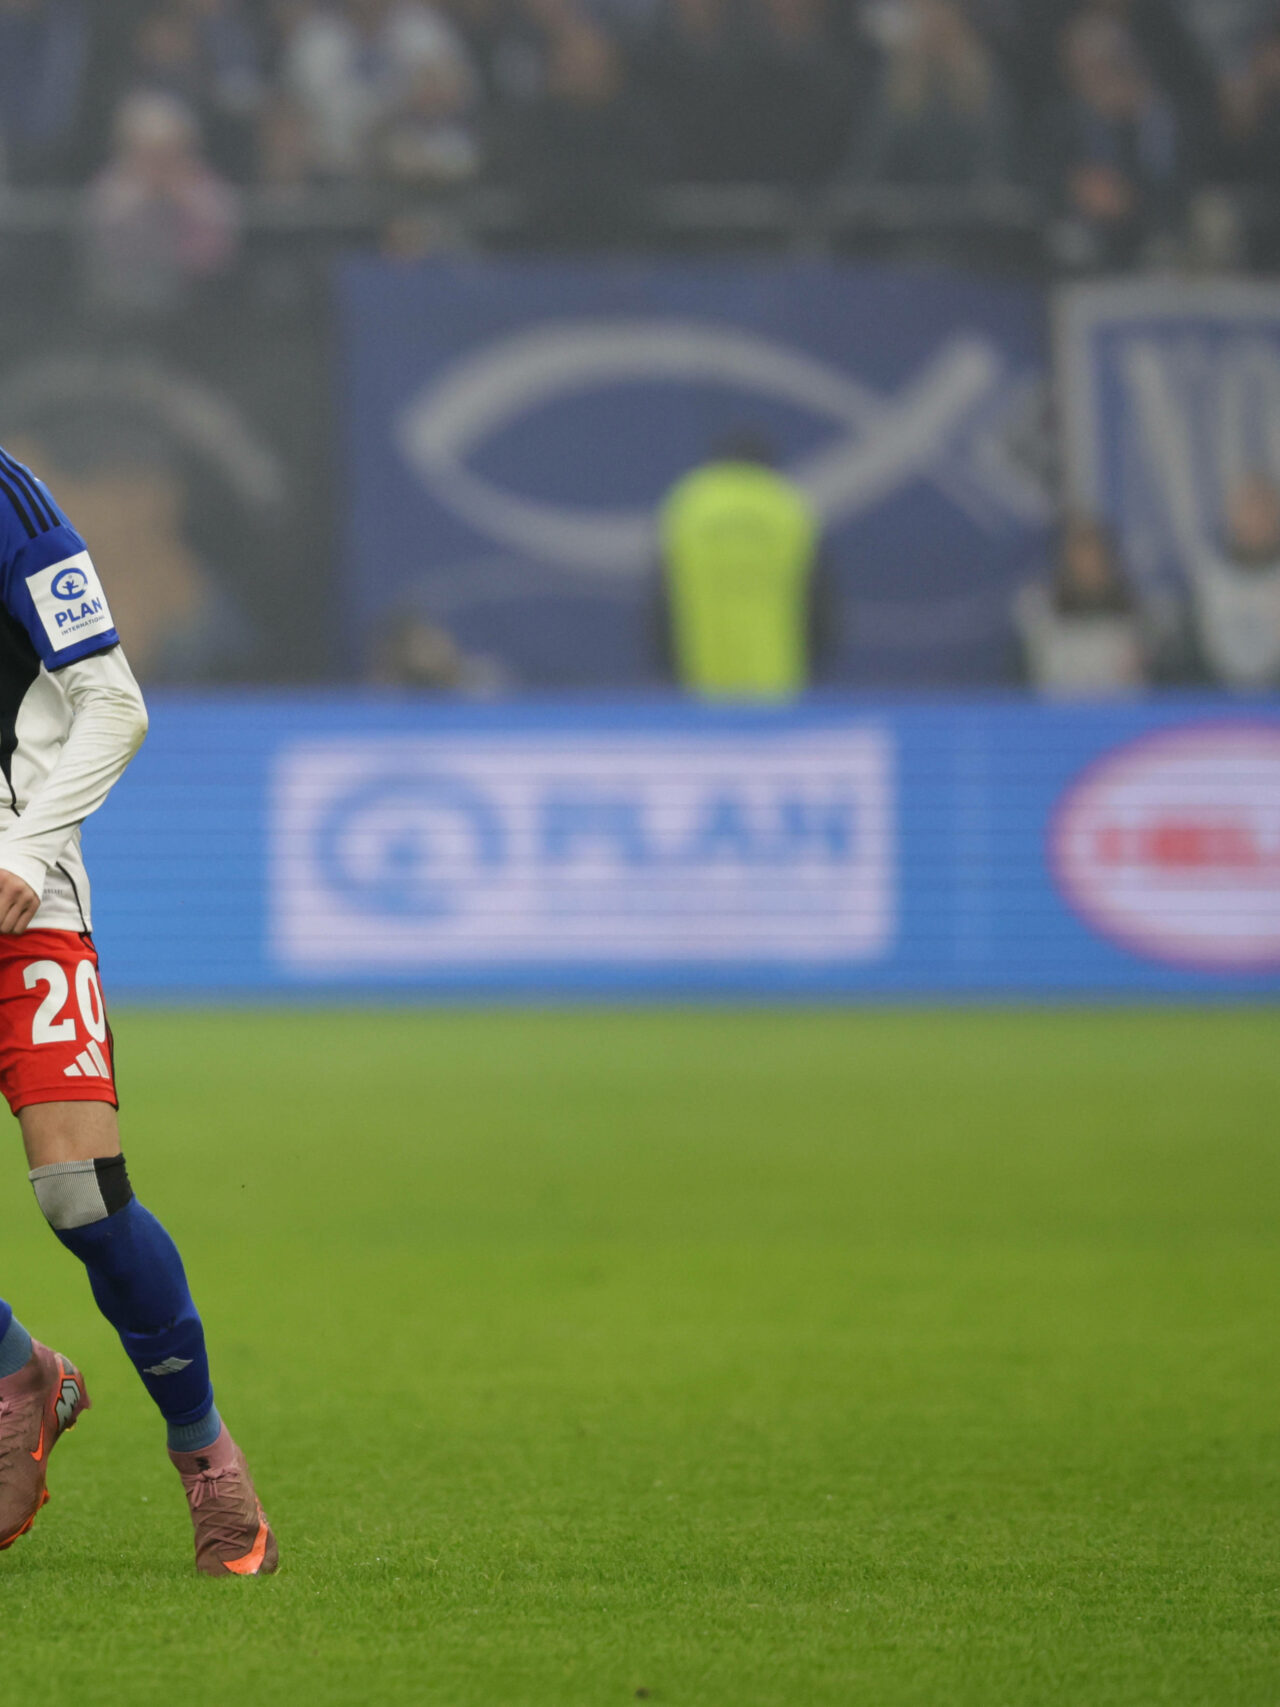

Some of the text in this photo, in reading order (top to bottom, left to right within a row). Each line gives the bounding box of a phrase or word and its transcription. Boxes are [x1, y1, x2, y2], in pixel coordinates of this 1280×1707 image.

[55, 597, 103, 628] PLAN
[61, 615, 105, 635] INTERNATIO
[533, 780, 862, 867] PLAN
[22, 959, 106, 1045] 20
